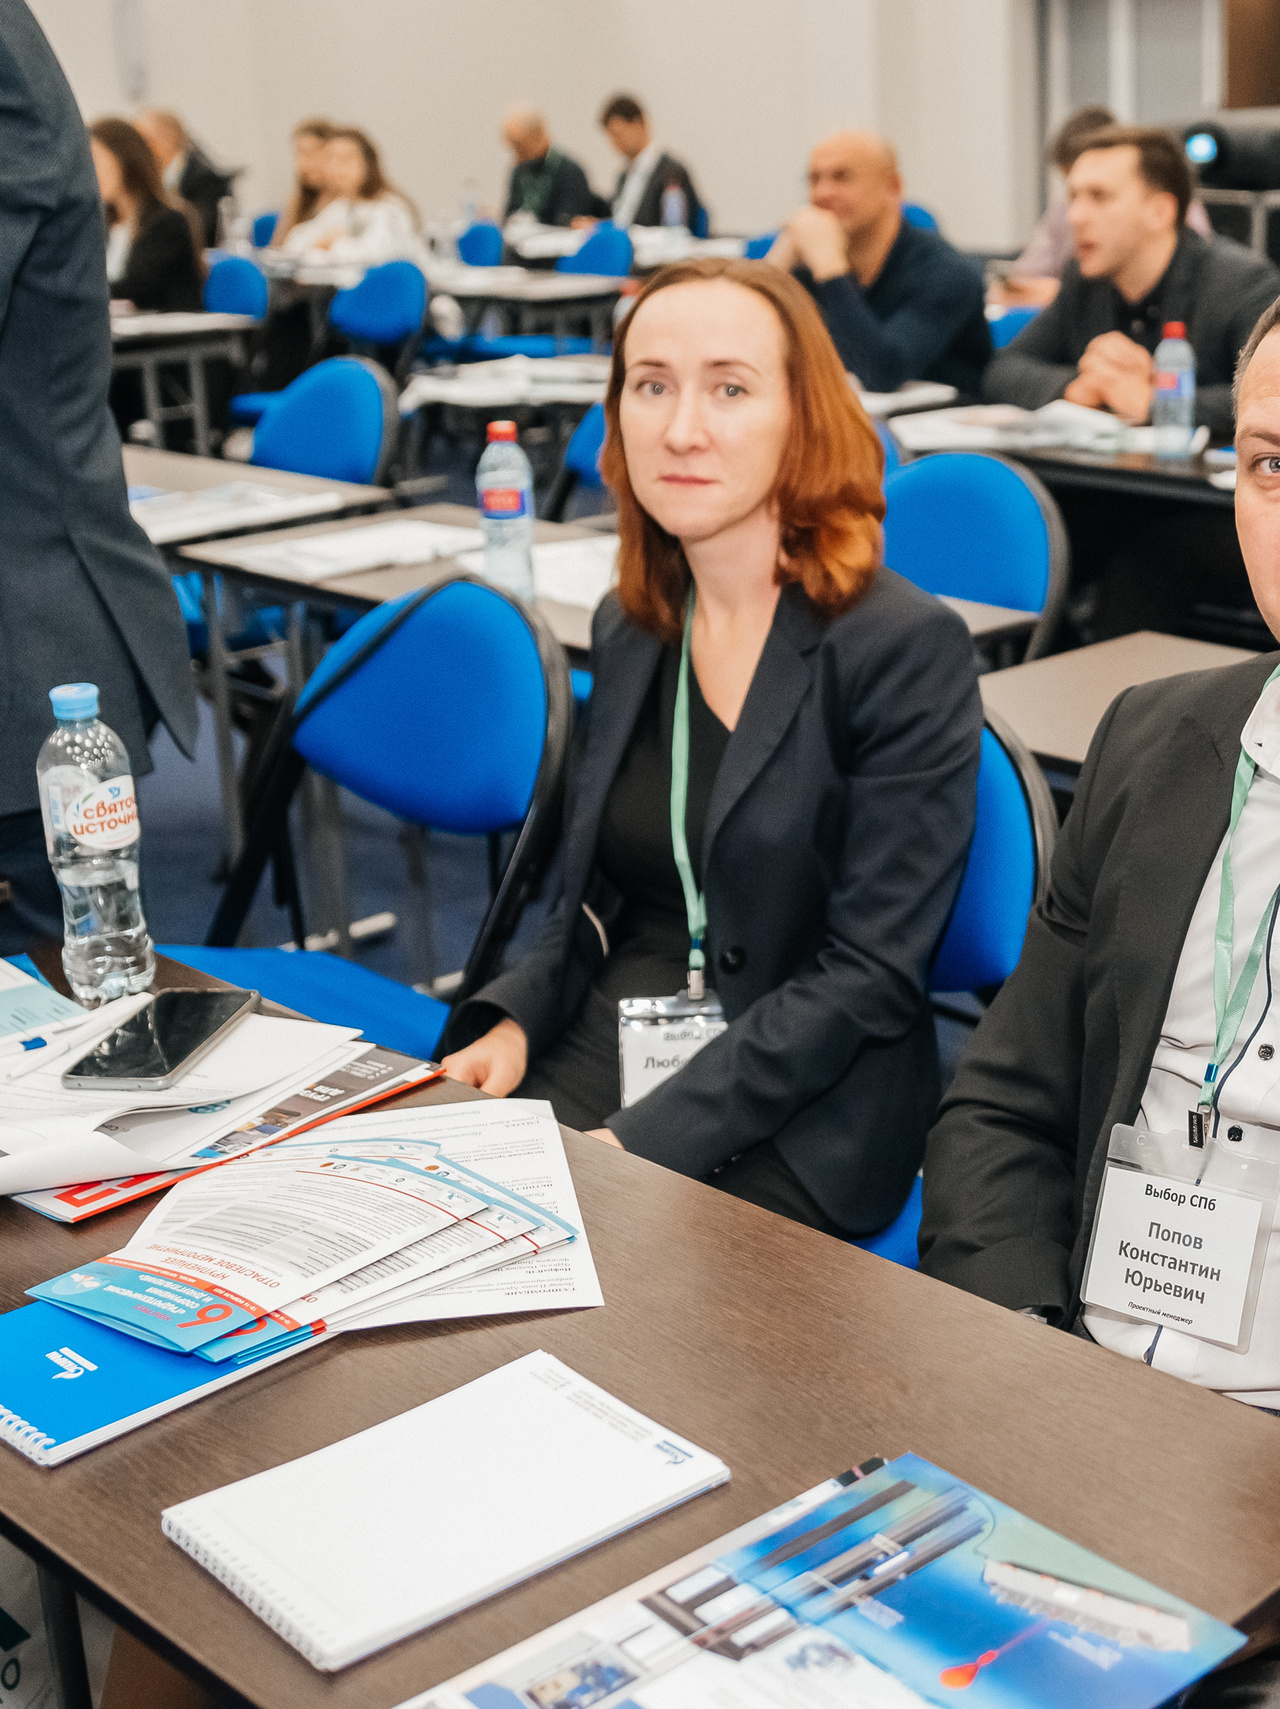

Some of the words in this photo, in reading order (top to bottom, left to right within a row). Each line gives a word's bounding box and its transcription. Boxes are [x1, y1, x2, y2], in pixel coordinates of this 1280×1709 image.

[1144, 1183, 1186, 1206] Выбор
[1190, 1194, 1217, 1212] СПб
[1147, 1221, 1204, 1250] Попов
[145, 1244, 212, 1264] МЕРОПРИЯТИЕ
[1118, 1240, 1222, 1282] Константин
[160, 1256, 230, 1281] КРУПНЕЙШЕЕ
[212, 1258, 281, 1288] ОТРАСЛЕВОЕ
[145, 1286, 200, 1309] СООРУЖЕНИЯ
[1124, 1268, 1206, 1305] Юрьевич
[131, 1304, 172, 1322] КОНГРЕСС
[176, 1304, 233, 1328] 6
[1127, 1301, 1162, 1317] Проектный
[1161, 1310, 1193, 1325] менеджер
